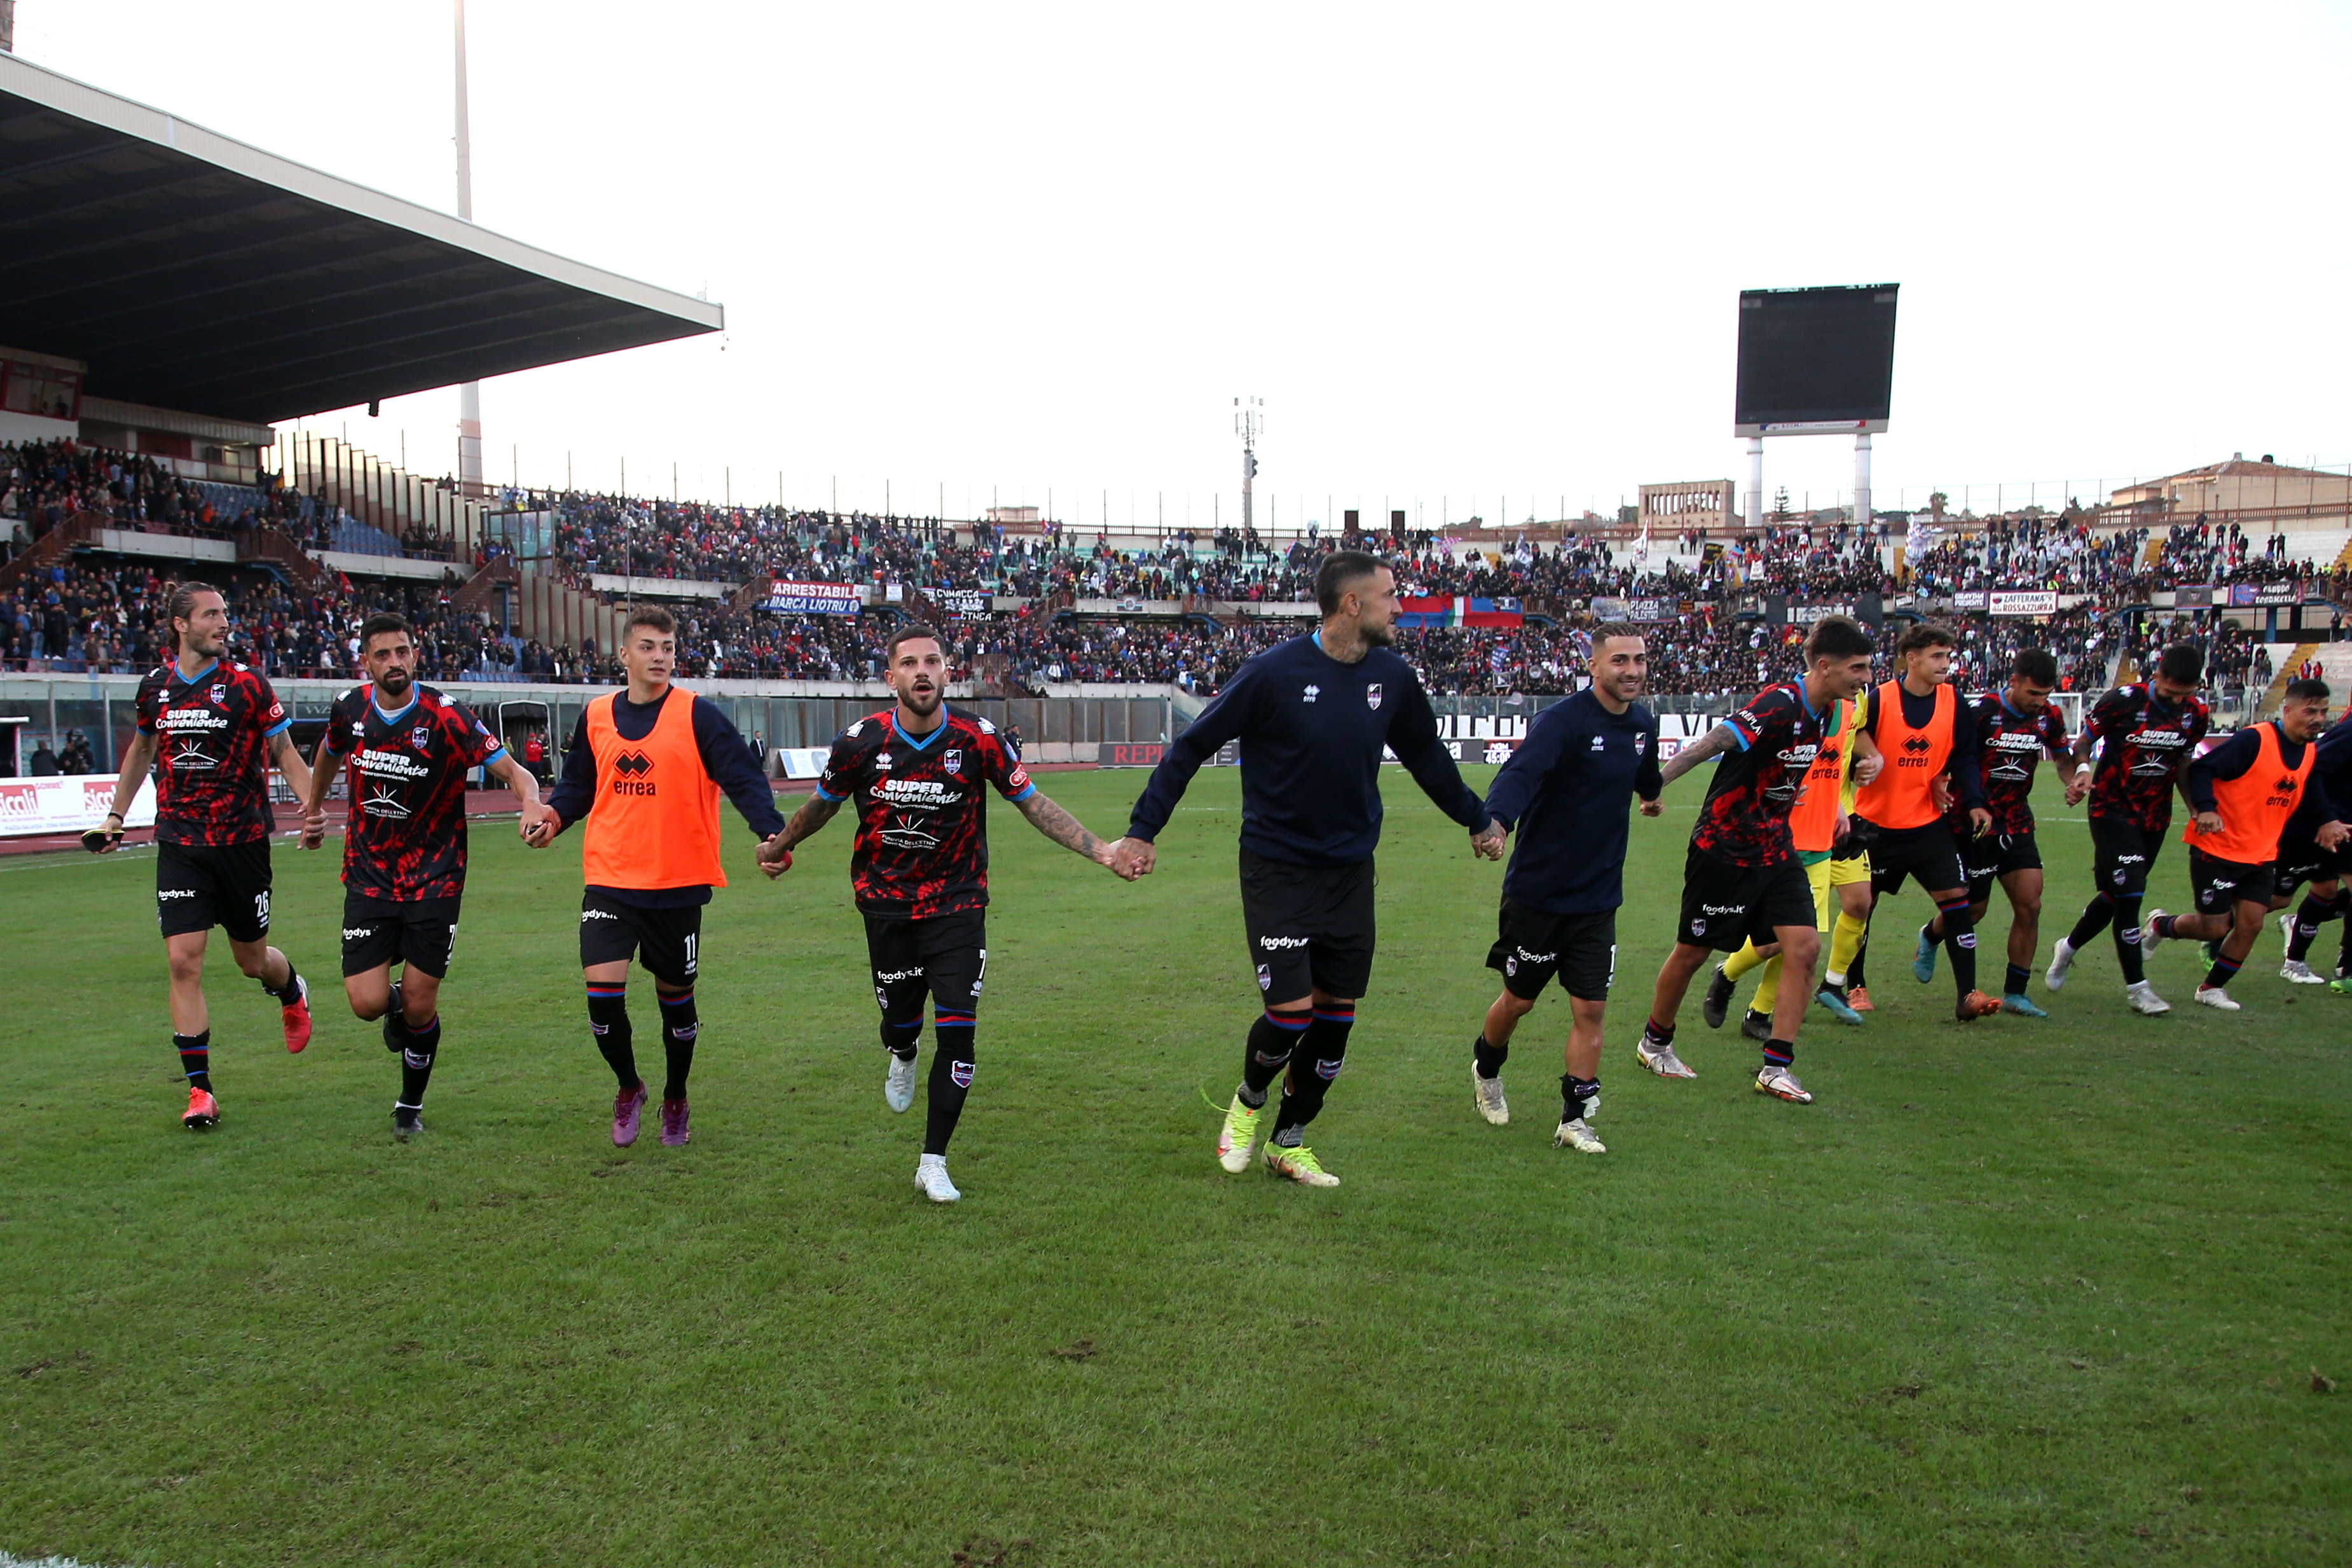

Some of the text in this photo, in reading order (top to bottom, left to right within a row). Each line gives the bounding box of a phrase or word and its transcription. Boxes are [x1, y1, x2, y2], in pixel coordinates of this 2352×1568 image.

[769, 596, 847, 611] MARCA LIOTRU
[1630, 600, 1658, 610] PIAZZA
[2004, 595, 2044, 603] ZAFFERANA
[166, 710, 210, 719] SUPER
[155, 718, 228, 729] Conveniente
[2000, 732, 2037, 743] SUPER
[2142, 729, 2179, 739] SUPER
[362, 748, 411, 766] SUPER
[350, 753, 429, 777] Conveniente
[1812, 768, 1840, 780] errea
[614, 780, 656, 796] errea
[885, 780, 944, 795] SUPER
[84, 784, 116, 811] sica
[869, 785, 963, 804] Conveniente
[2266, 796, 2290, 808] erre
[158, 890, 195, 901] foodys.it
[255, 890, 269, 918] 26
[1703, 904, 1744, 916] foodys.it
[684, 932, 696, 961] 11
[878, 967, 923, 984] foodys.it
